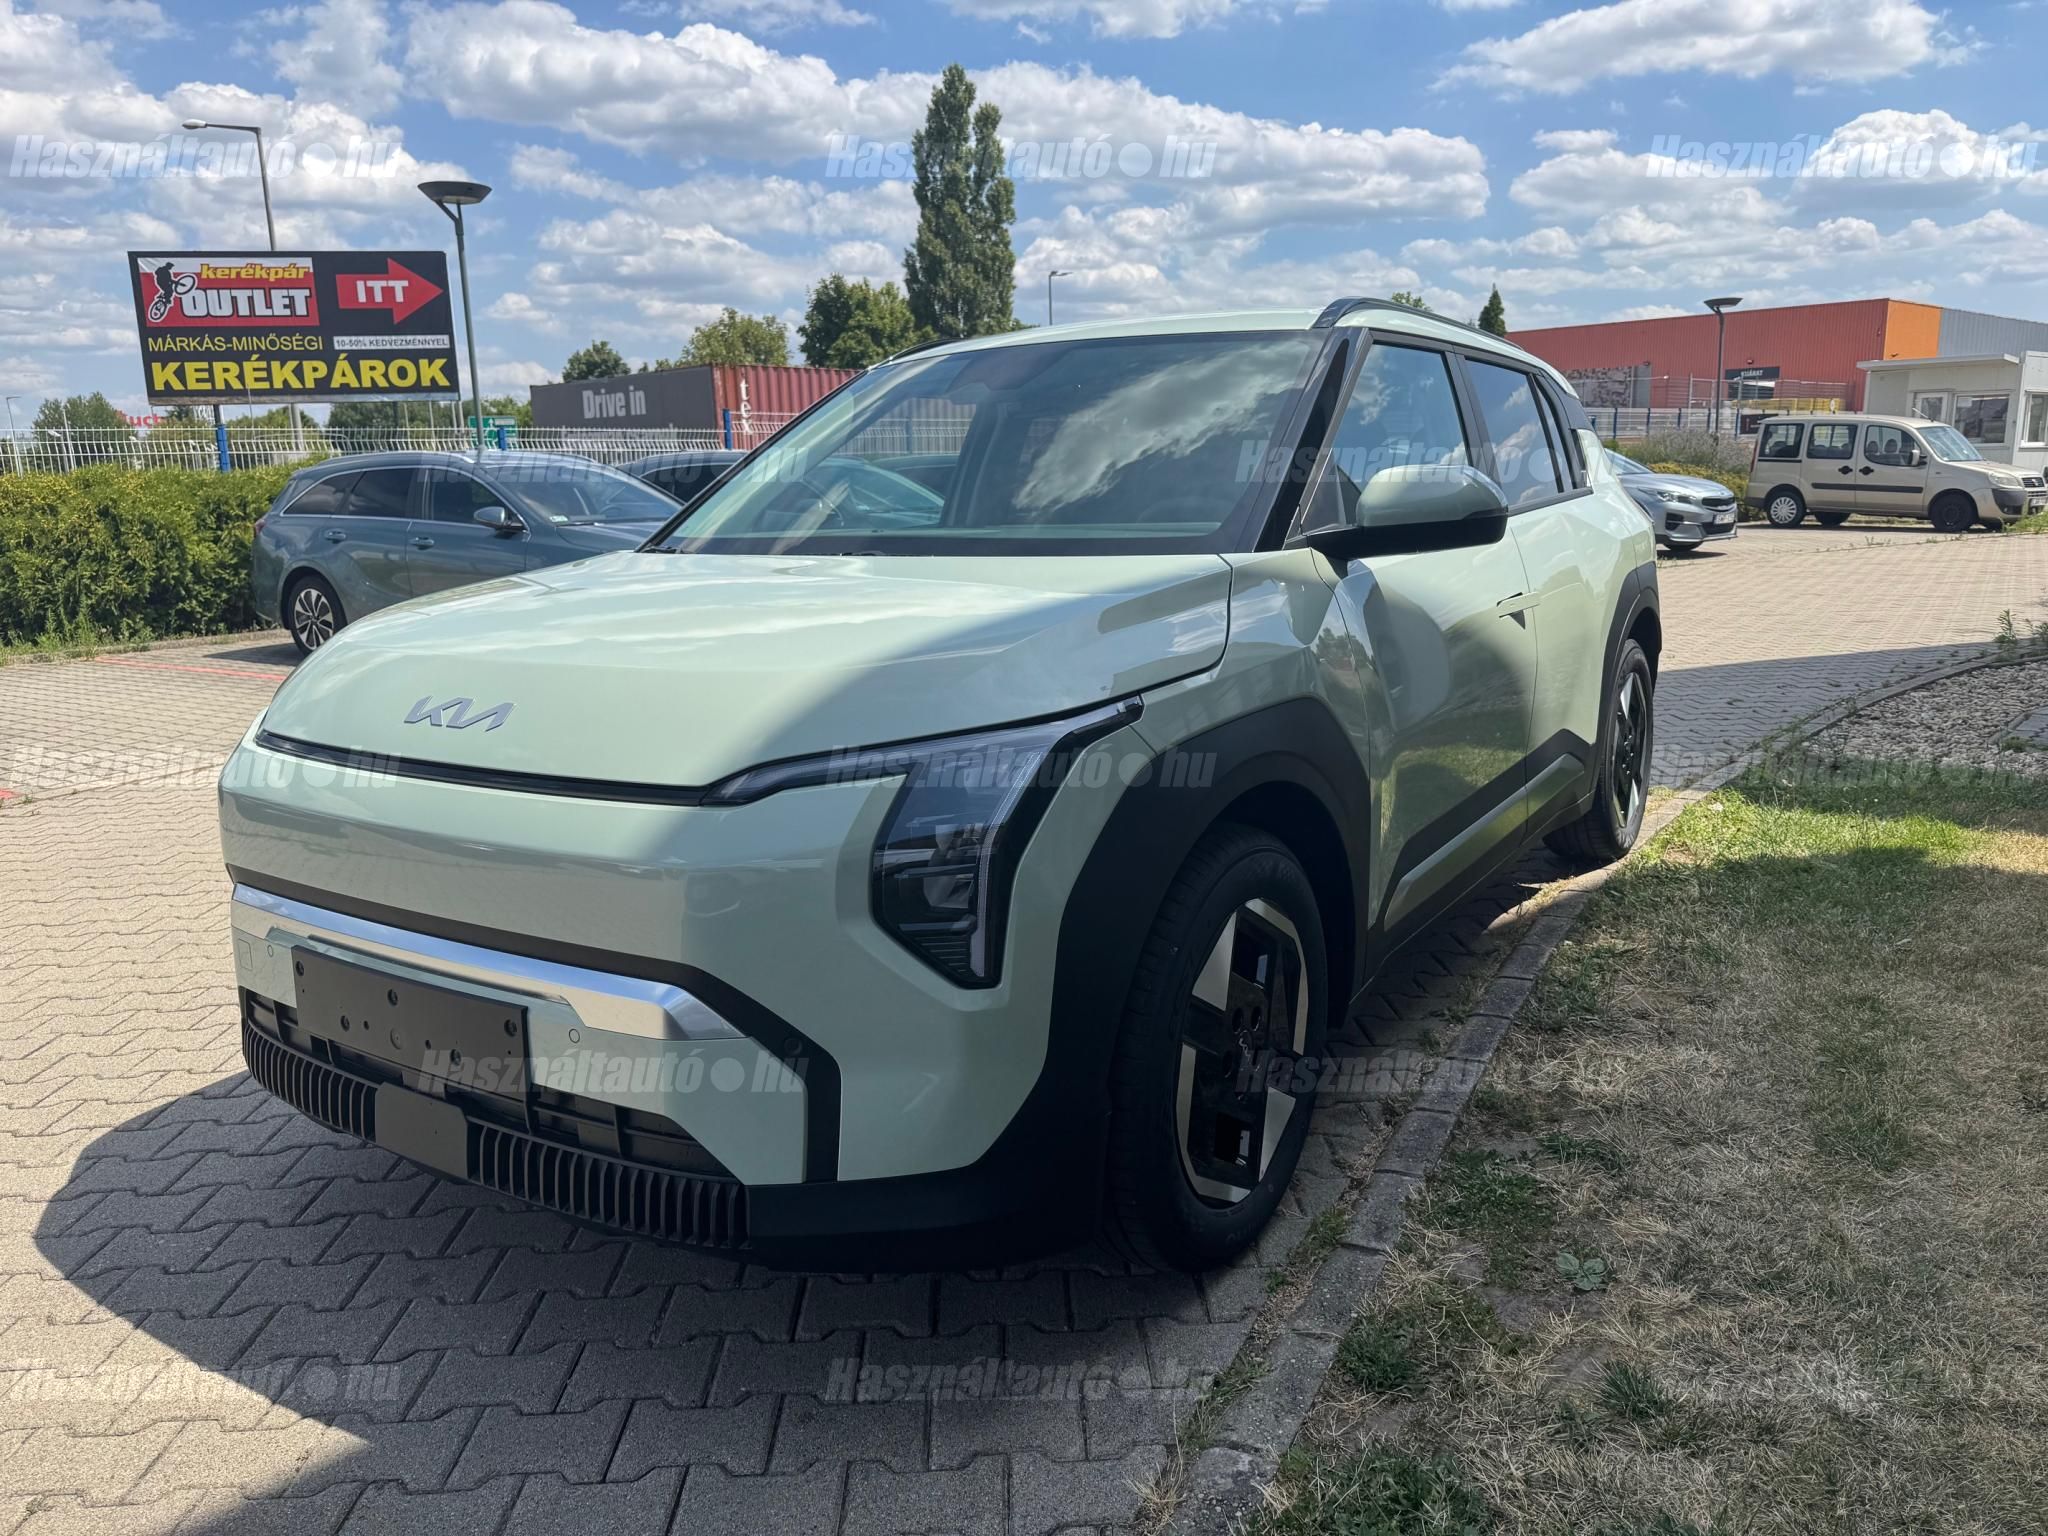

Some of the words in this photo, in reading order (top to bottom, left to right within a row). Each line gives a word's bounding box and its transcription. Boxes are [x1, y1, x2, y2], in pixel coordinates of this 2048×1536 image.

[200, 263, 310, 282] kerékpár
[182, 289, 311, 316] OUTLET
[356, 280, 408, 303] ITT
[148, 333, 323, 351] MÁRKÁS-MINŐSÉGI
[369, 338, 448, 347] KEDVEZMÉNNYEL
[152, 353, 450, 391] KERÉKPÁROK
[582, 388, 626, 419] Drive
[629, 385, 646, 416] in
